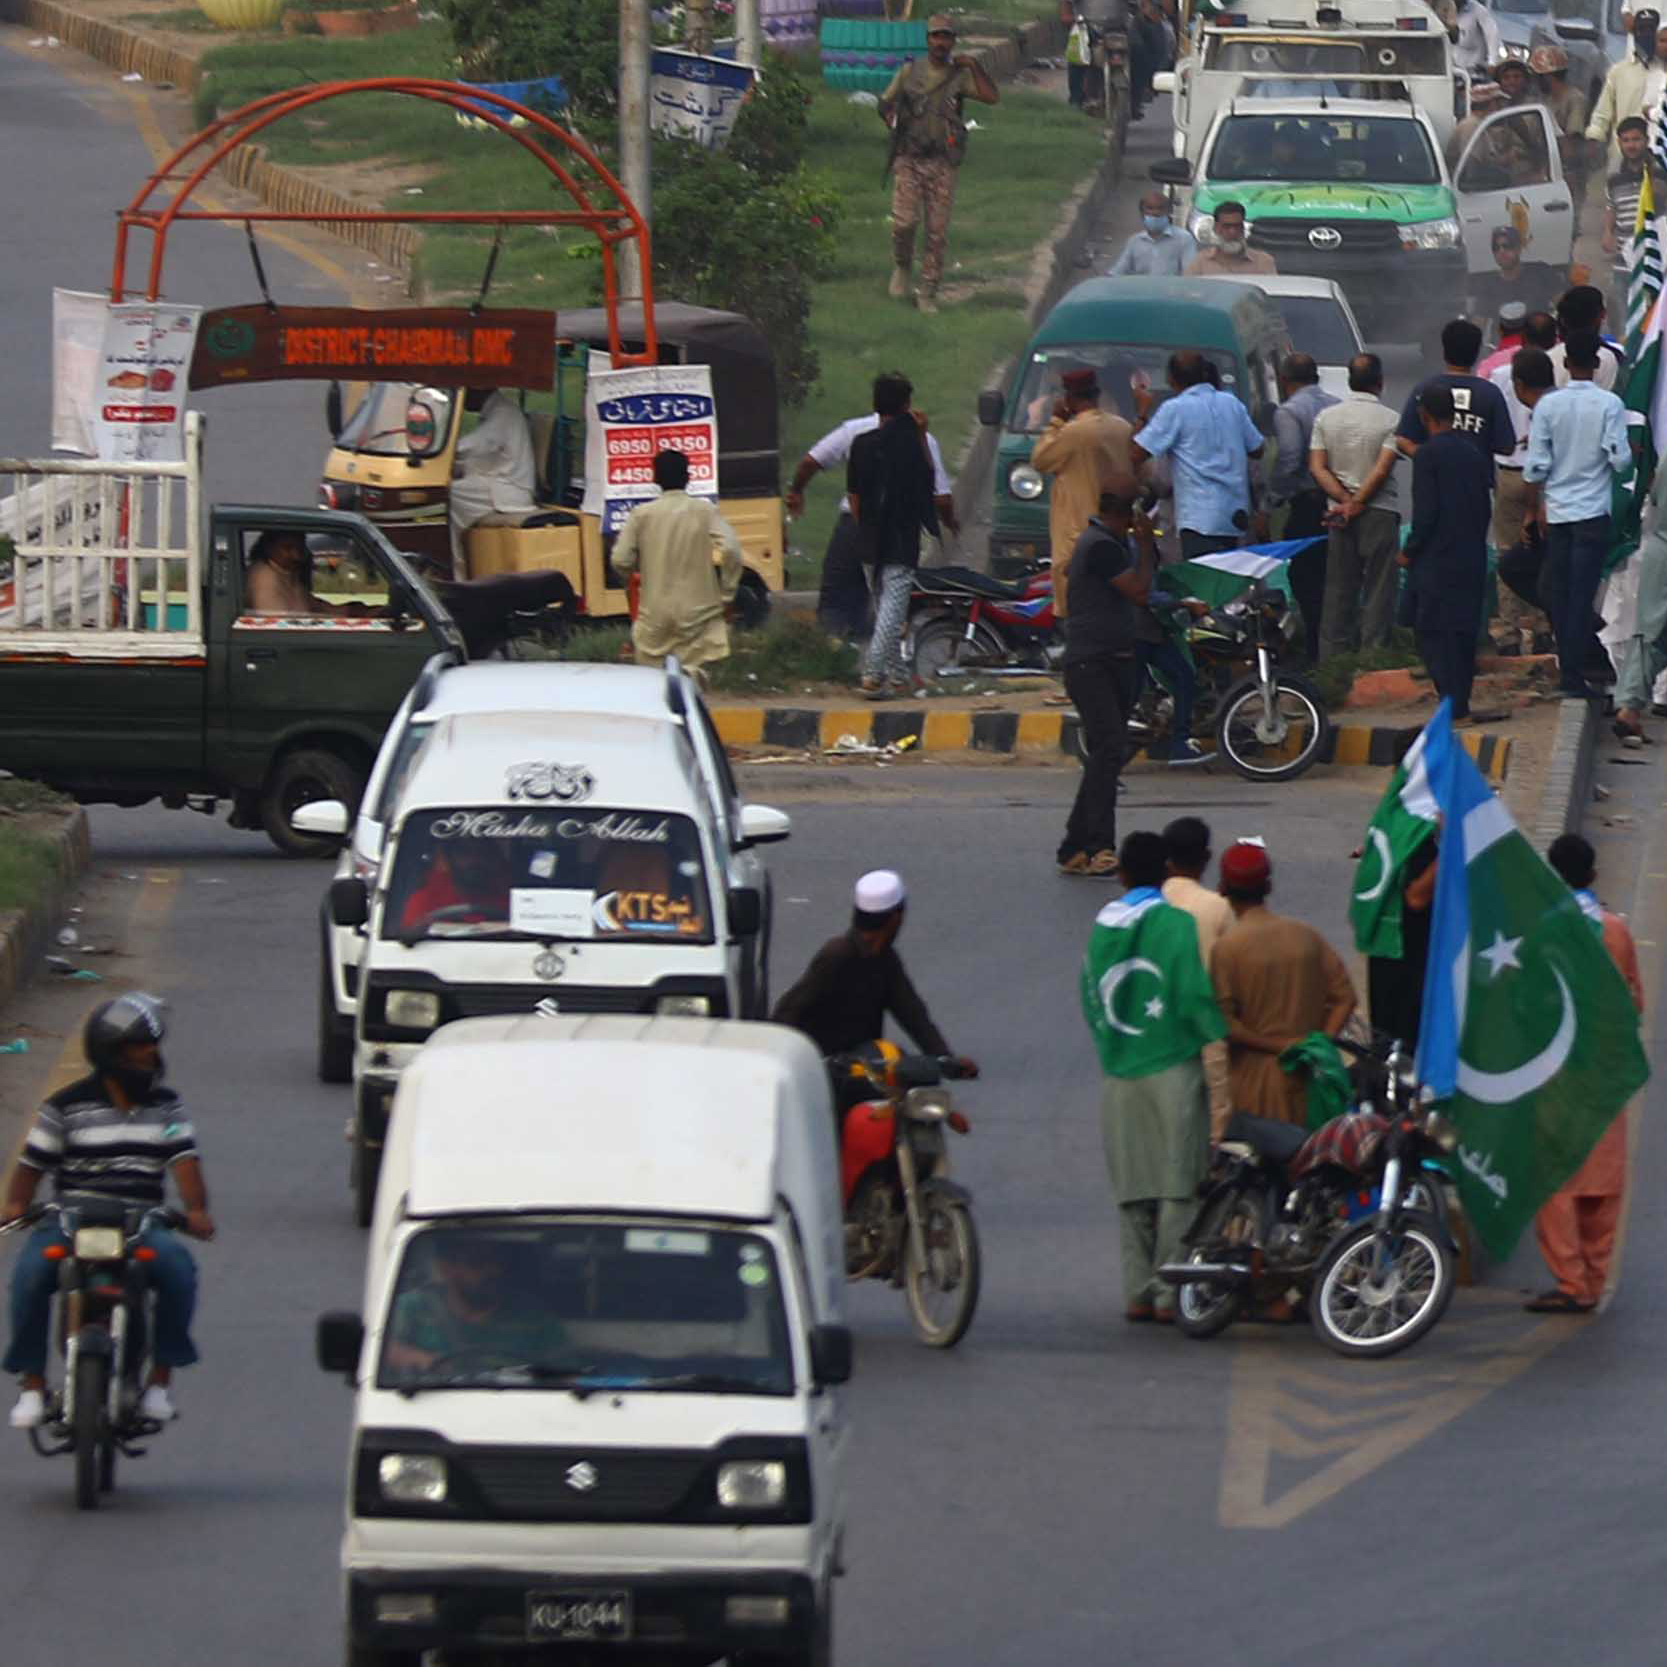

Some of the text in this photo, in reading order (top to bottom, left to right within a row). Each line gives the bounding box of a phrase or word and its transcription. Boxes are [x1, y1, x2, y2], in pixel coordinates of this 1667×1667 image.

[1451, 412, 1485, 434] AFF
[608, 435, 707, 454] 6950 9350
[610, 466, 654, 483] 4450
[430, 810, 670, 842] Masha Allah
[617, 890, 669, 922] KTS
